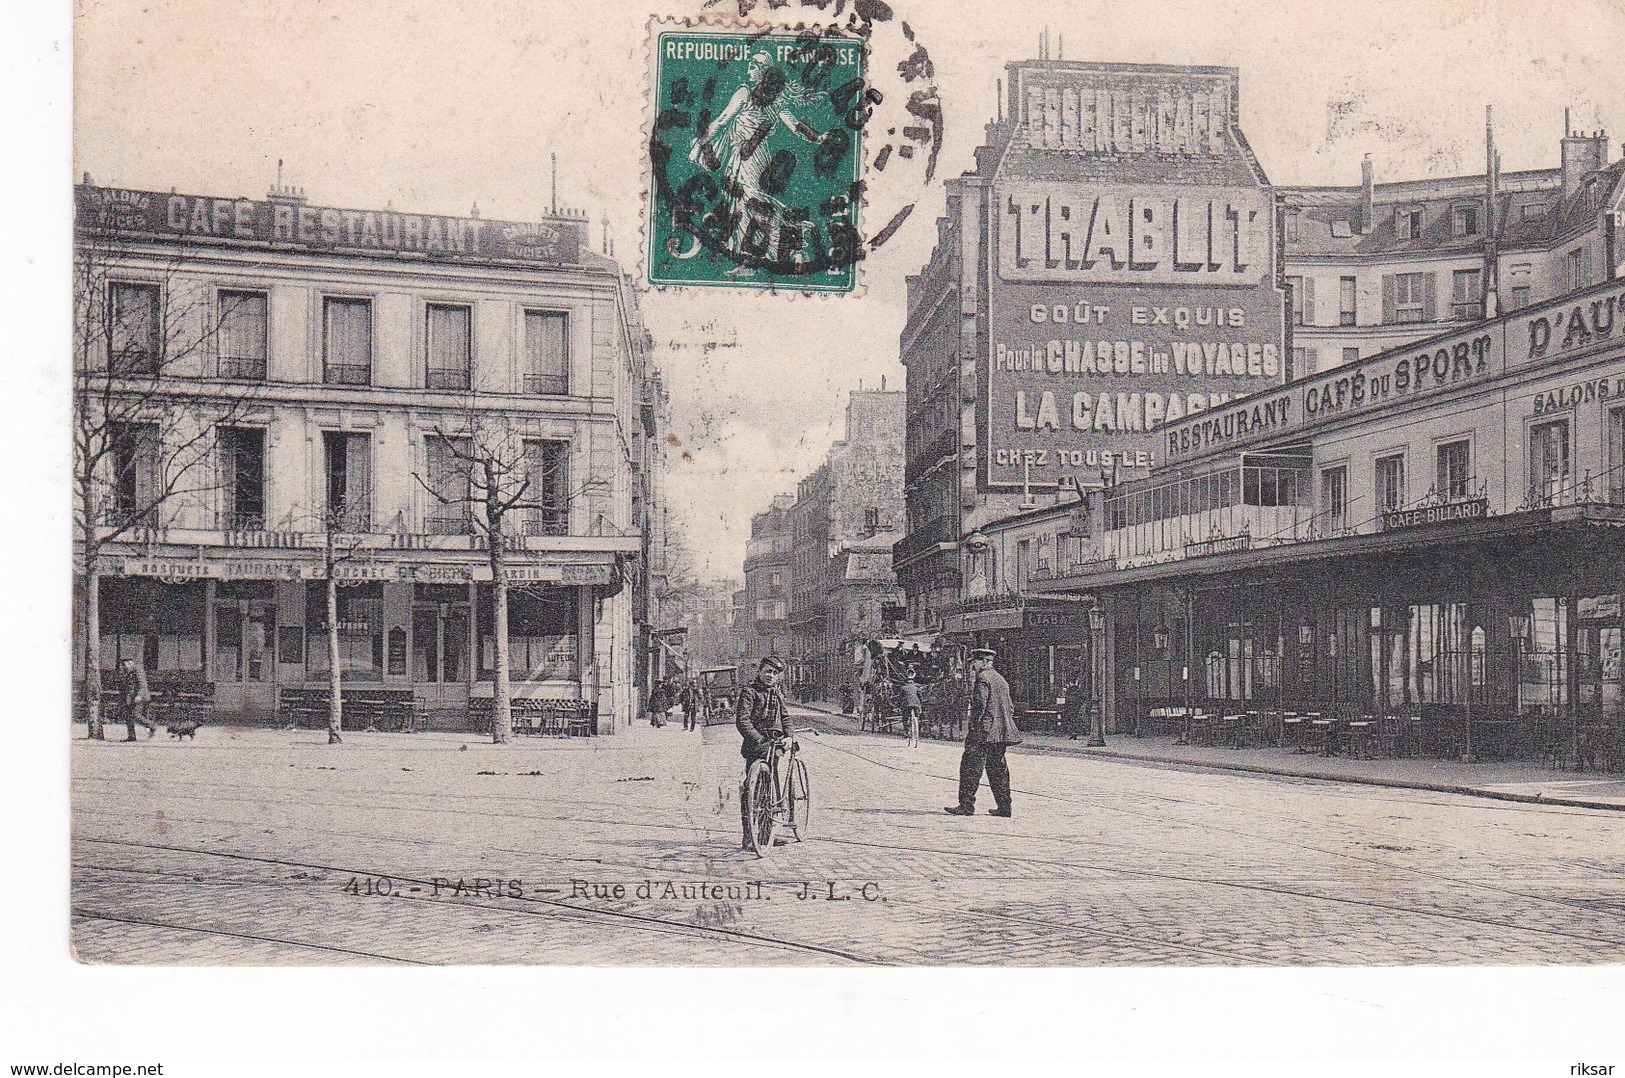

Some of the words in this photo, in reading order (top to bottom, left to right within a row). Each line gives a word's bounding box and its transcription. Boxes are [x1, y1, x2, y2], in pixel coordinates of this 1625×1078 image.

[274, 205, 484, 251] RESTAURANT
[1005, 194, 1262, 273] TRABLIT
[1030, 299, 1110, 325] GOÛT
[1131, 305, 1246, 330] EXQUIS
[1046, 340, 1145, 376] CHASSE
[1171, 341, 1279, 377] VOYAGES
[1016, 390, 1060, 431] LA
[1168, 395, 1291, 457] RESTAURANT
[1303, 368, 1367, 416] CAFÉ
[1370, 373, 1391, 399] DU
[1395, 334, 1492, 393] SPORT
[1533, 379, 1609, 415] SALONS
[996, 449, 1049, 468] CHEZ
[1059, 449, 1116, 467] TOUS
[503, 568, 540, 579] ARDIN
